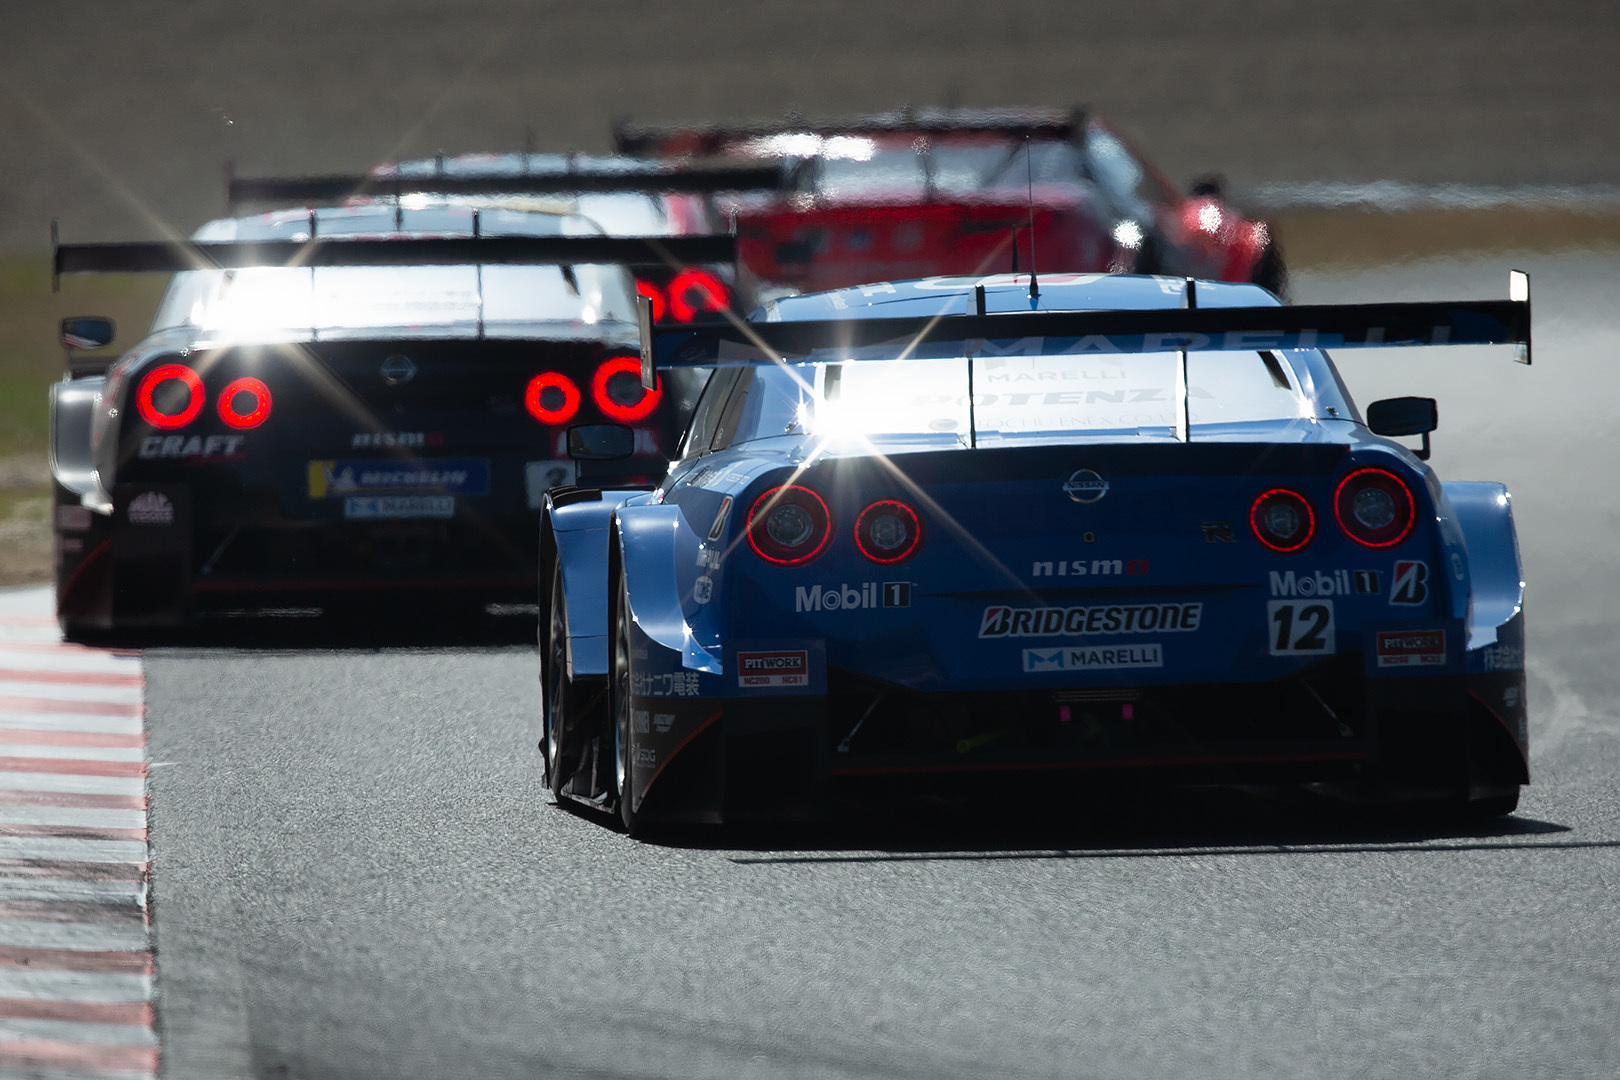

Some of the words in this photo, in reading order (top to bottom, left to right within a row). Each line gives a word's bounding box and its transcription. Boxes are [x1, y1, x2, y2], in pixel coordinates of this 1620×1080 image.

[987, 368, 1128, 385] MARELLI
[911, 385, 1217, 409] POTENZA
[138, 433, 246, 460] CRAFT
[1032, 559, 1149, 576] nismo
[1269, 567, 1350, 597] Mobil
[1356, 571, 1379, 595] 1
[796, 582, 877, 613] Mobil
[981, 605, 1202, 637] BRIDGESTONE
[1273, 604, 1331, 652] 12
[1071, 648, 1158, 666] MARELLI
